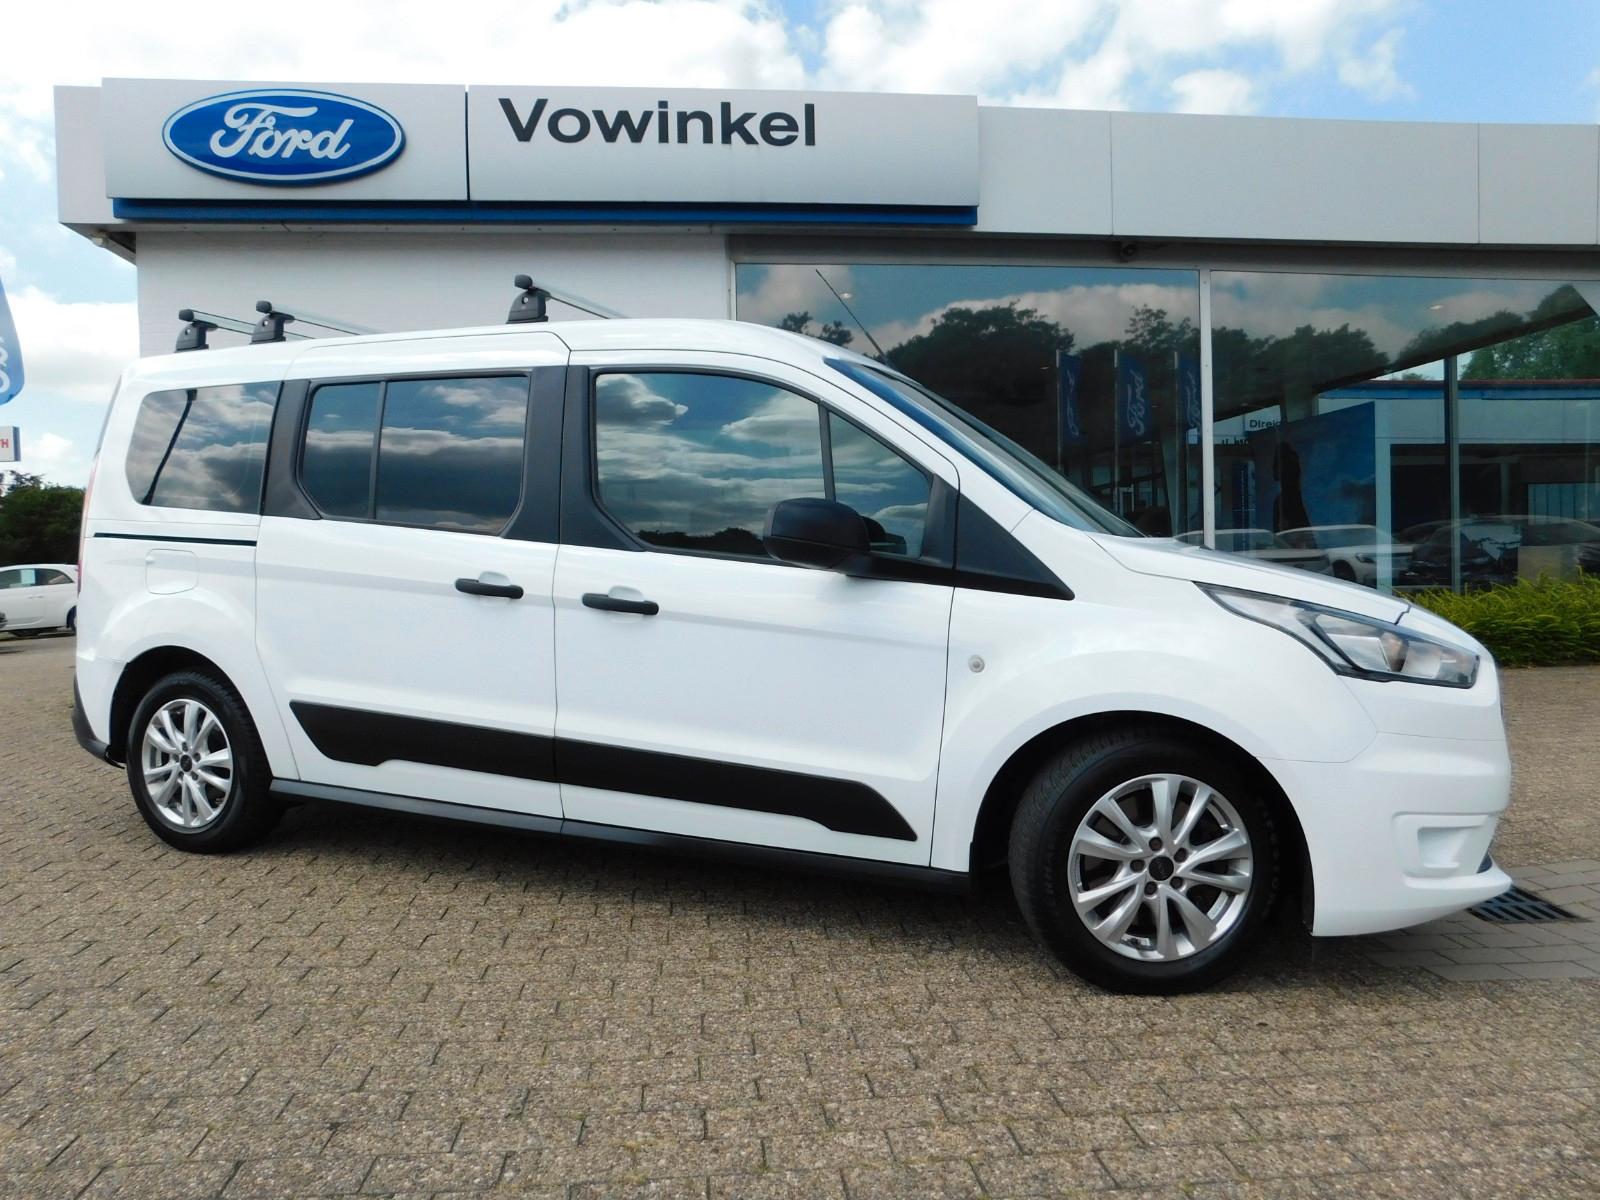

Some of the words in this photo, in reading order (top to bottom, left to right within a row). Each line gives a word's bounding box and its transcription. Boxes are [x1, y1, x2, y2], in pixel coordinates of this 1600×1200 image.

[209, 102, 354, 160] Ford
[498, 97, 816, 147] Vowinkel
[1126, 368, 1145, 437] Ford
